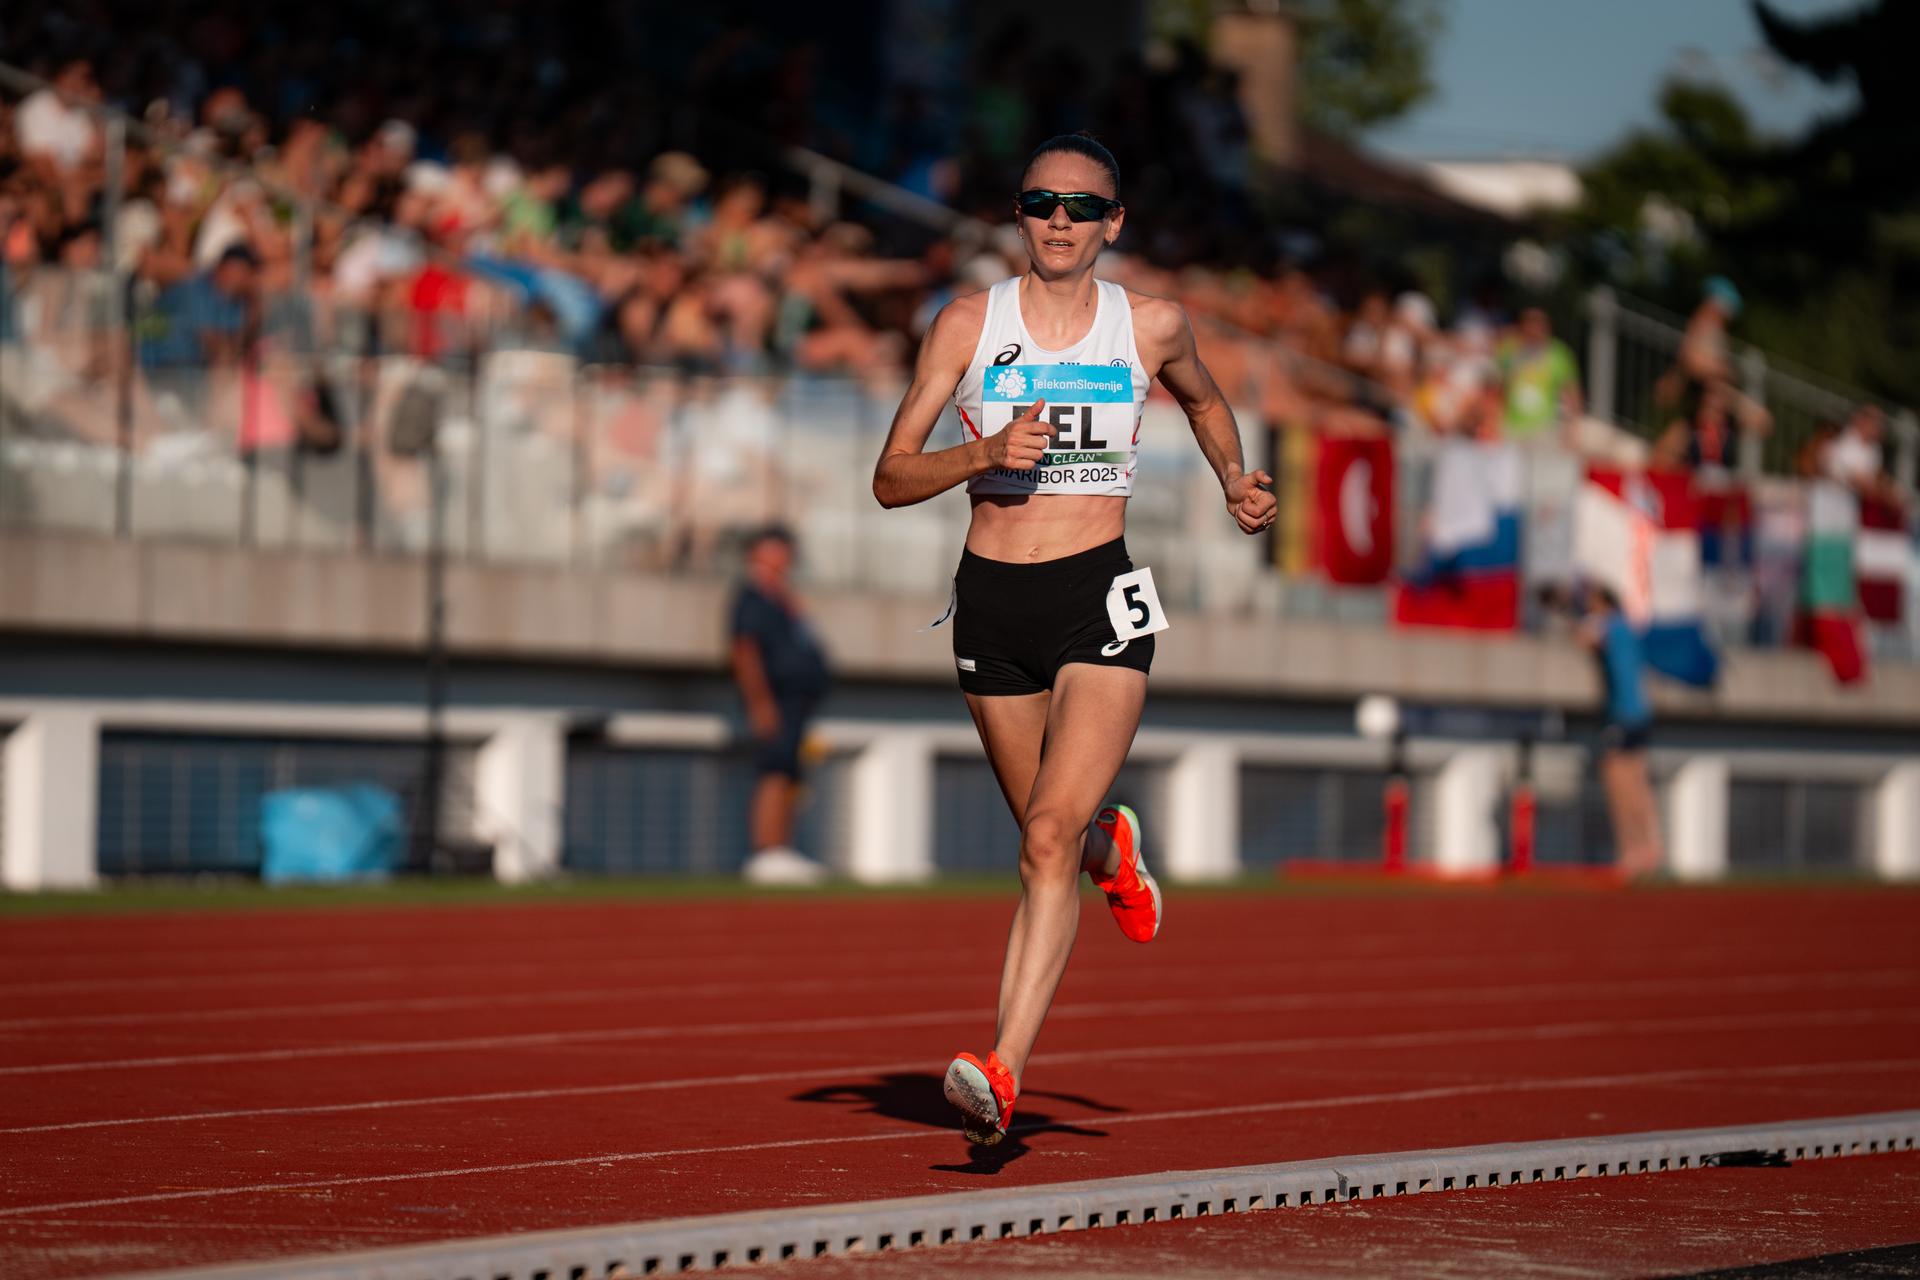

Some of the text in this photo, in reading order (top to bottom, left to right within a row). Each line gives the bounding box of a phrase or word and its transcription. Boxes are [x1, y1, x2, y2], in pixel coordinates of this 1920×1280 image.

[1032, 379, 1123, 393] TelekomSlovenije
[1080, 467, 1118, 483] 2025
[1122, 583, 1150, 630] 5
